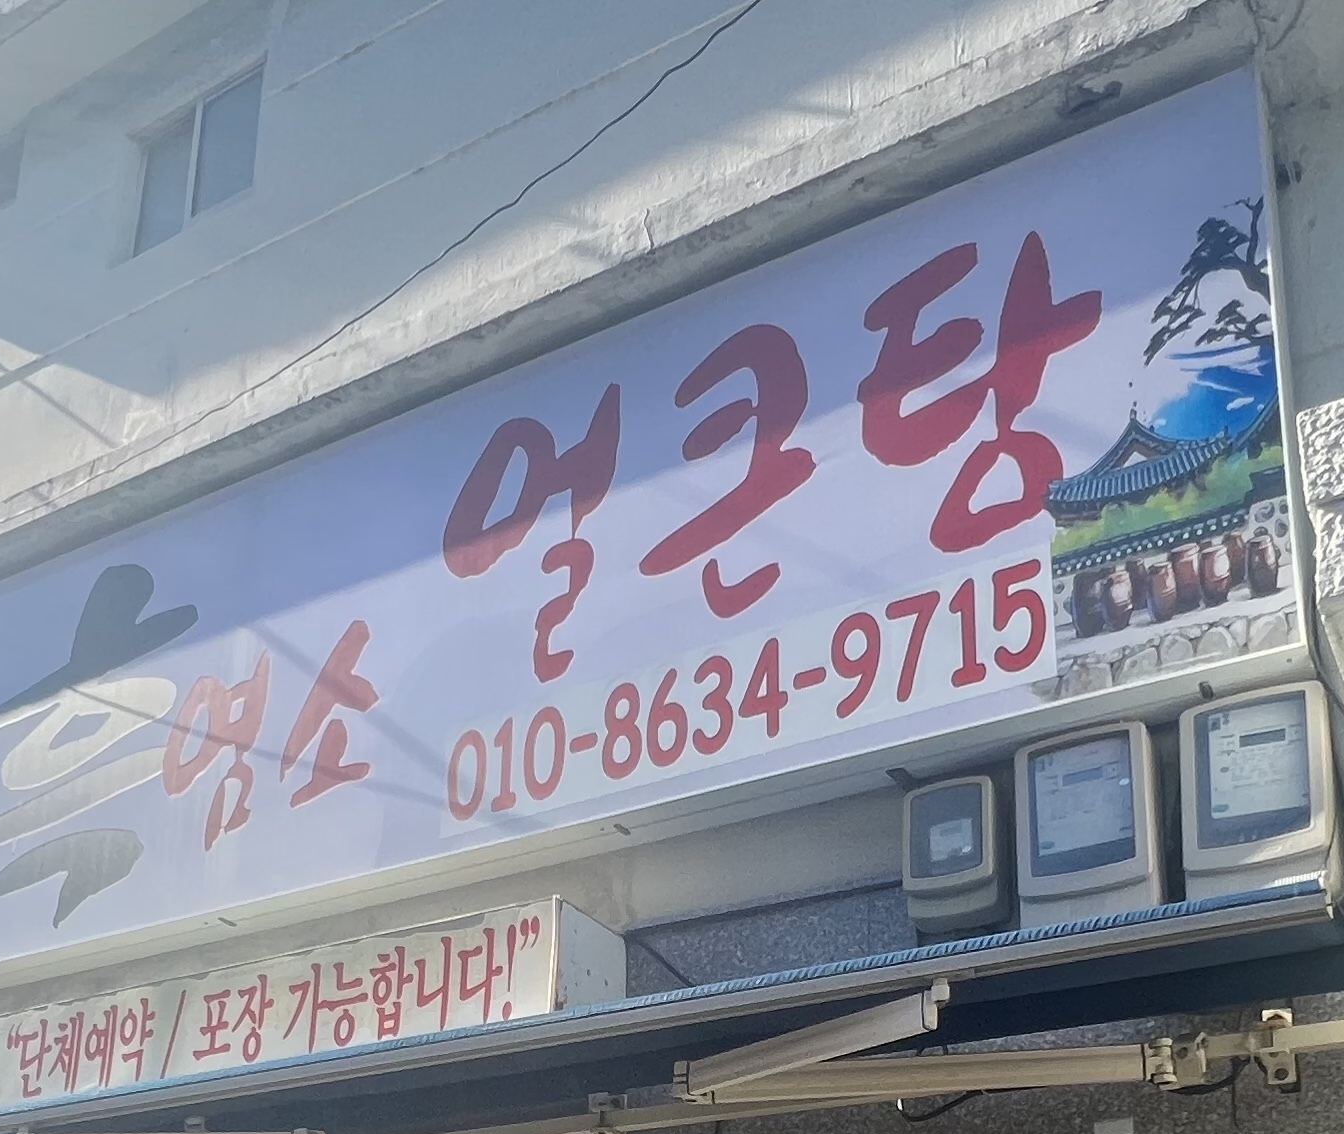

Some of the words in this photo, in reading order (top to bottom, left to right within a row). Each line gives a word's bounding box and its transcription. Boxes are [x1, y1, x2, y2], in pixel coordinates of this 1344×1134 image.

[443, 231, 1102, 682] 얼큰탕
[446, 558, 1047, 820] 010-8634-9715
[192, 975, 275, 1060] 포장
